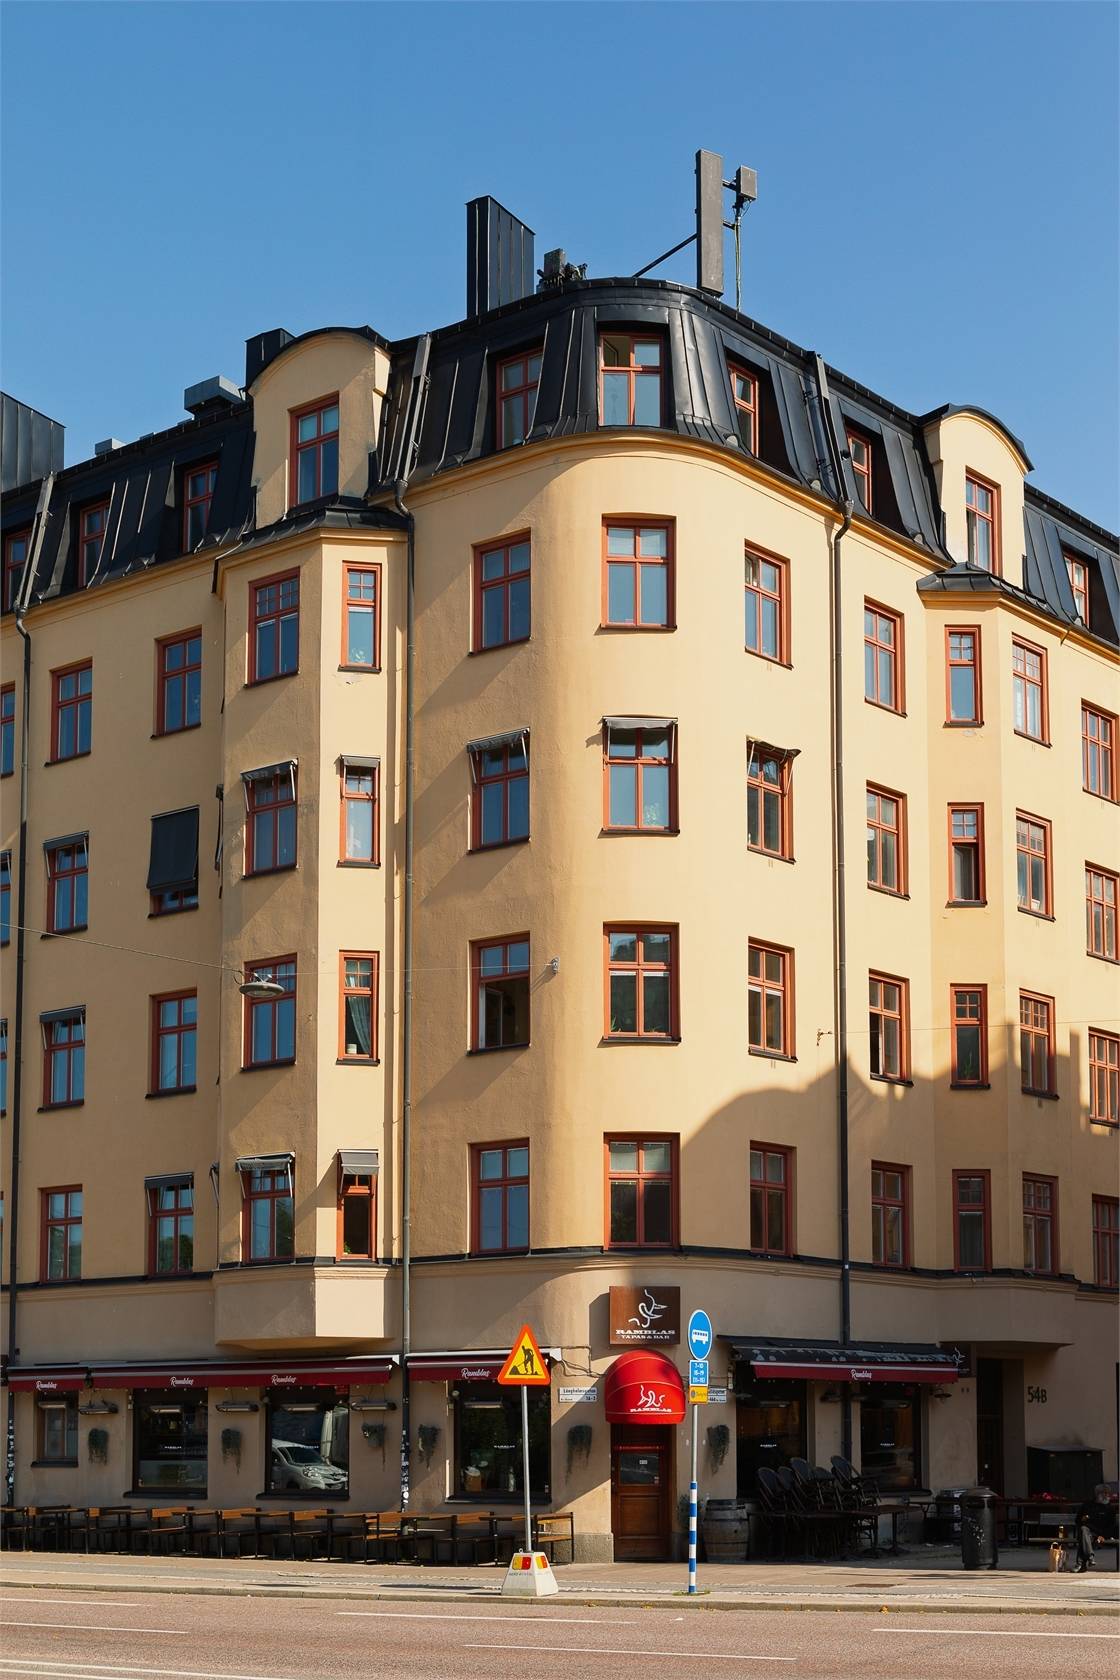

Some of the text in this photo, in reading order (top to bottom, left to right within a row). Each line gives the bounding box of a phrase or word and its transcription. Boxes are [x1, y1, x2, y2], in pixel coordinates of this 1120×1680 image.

[461, 1368, 490, 1379] Ramblas
[850, 1369, 872, 1380] Ramblas
[170, 1376, 194, 1387] Ramblas
[271, 1374, 297, 1385] Ramblas
[1027, 1386, 1047, 1403] 54B
